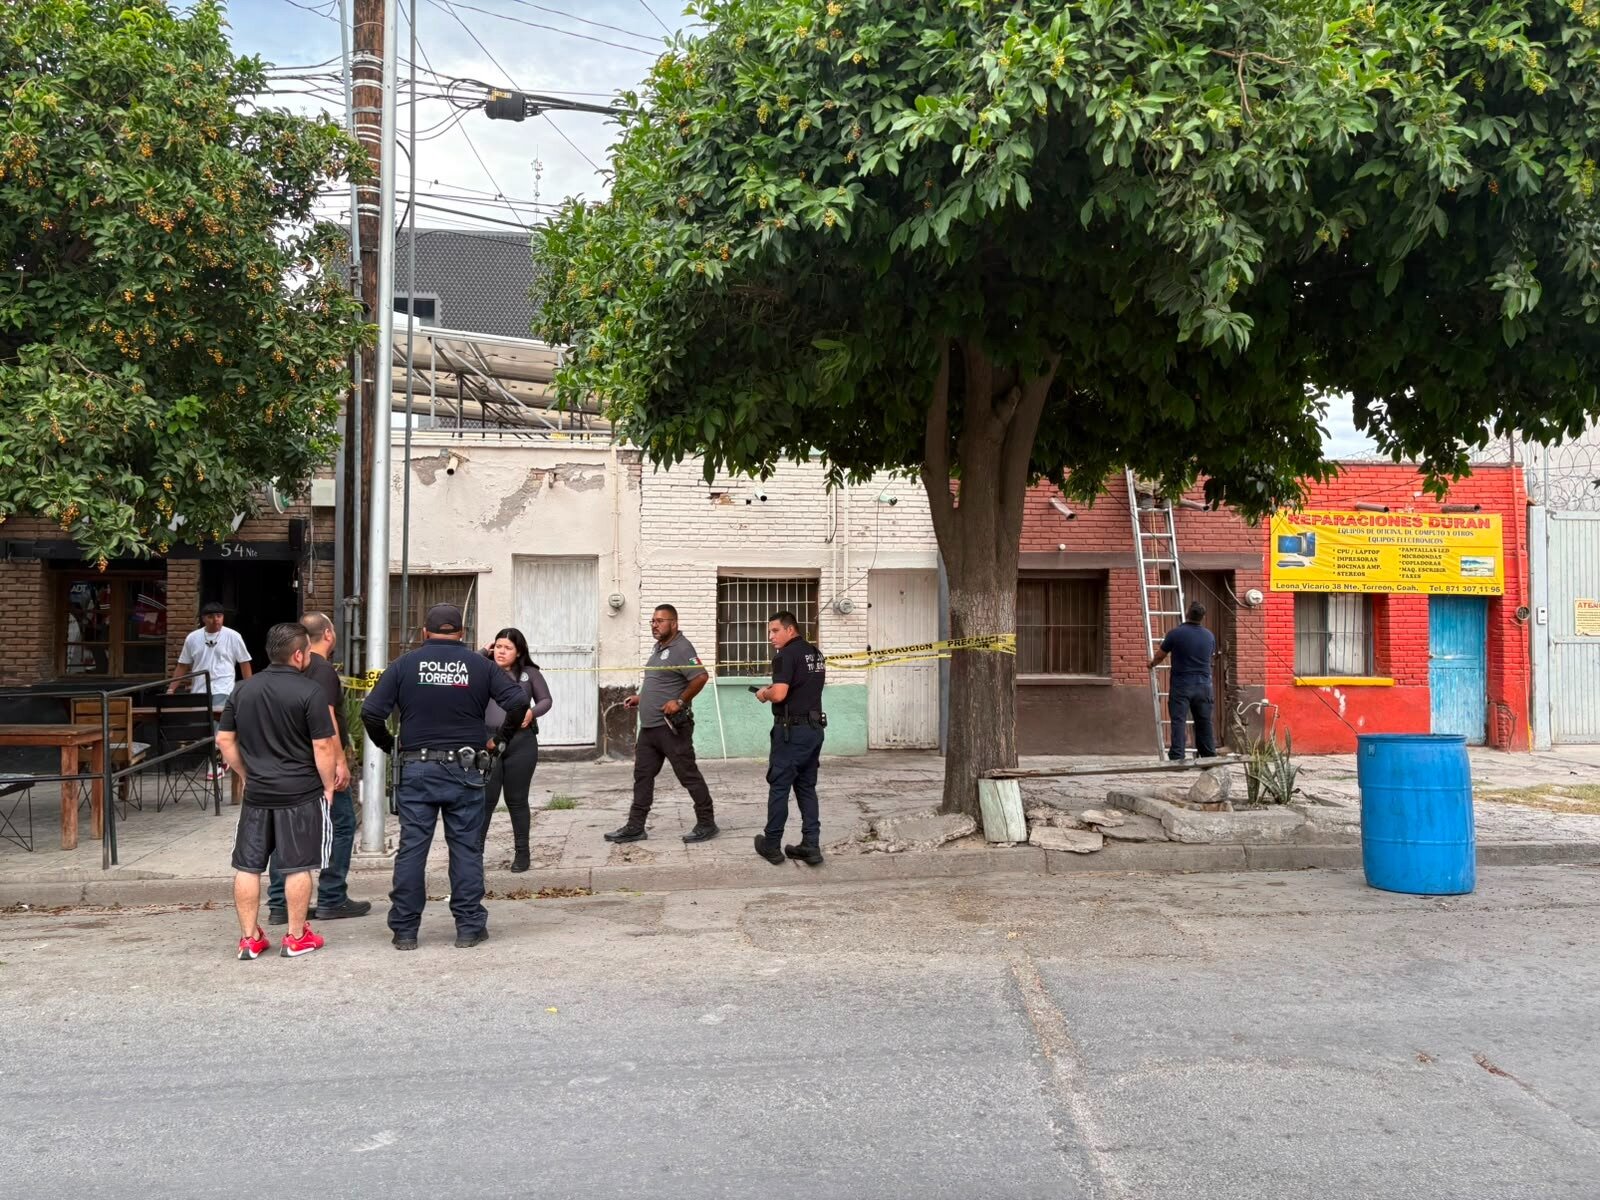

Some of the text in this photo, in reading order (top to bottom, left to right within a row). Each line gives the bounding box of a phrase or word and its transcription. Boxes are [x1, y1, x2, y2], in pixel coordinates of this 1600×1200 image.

[1288, 514, 1422, 527] REPARACIONES
[221, 543, 243, 557] 54
[70, 584, 87, 592] ADT
[420, 660, 468, 672] POLICÍA
[418, 672, 468, 684] TORREÓN
